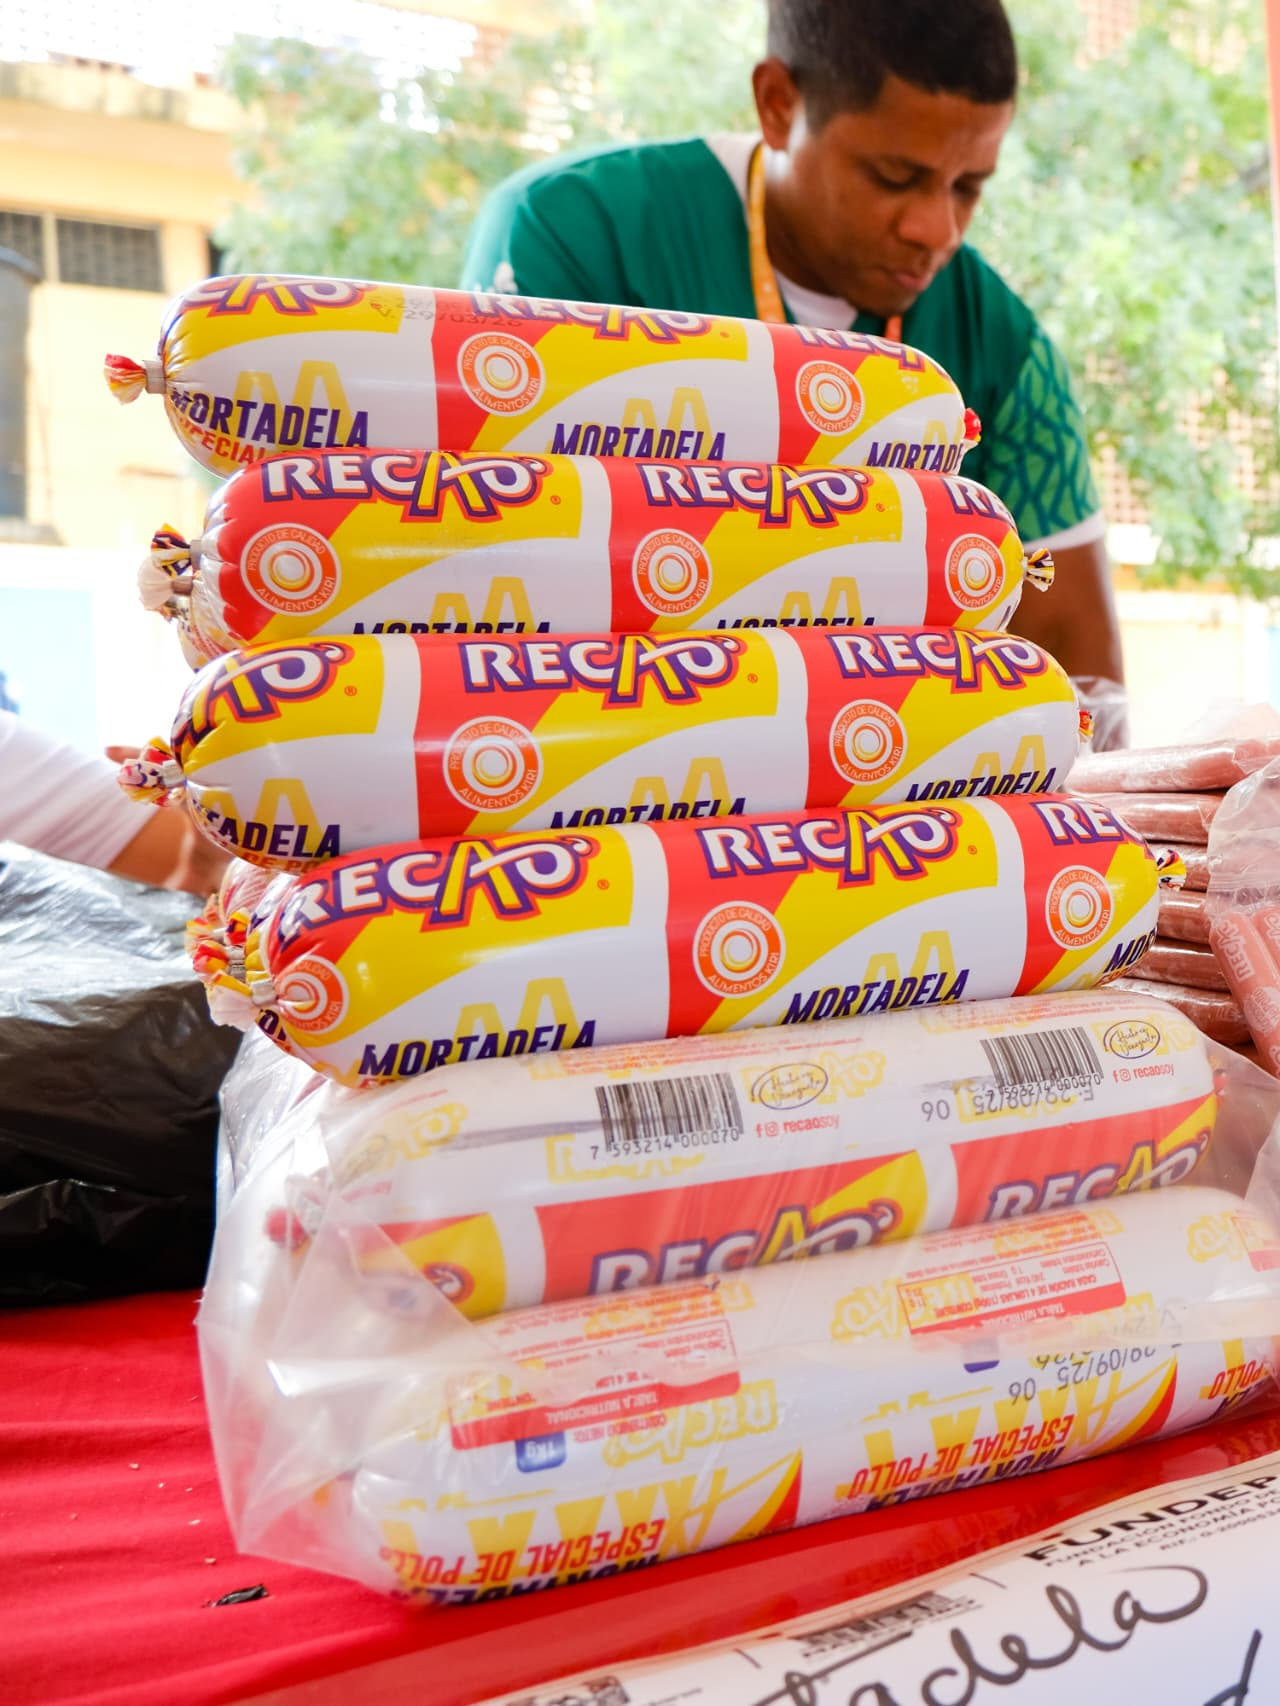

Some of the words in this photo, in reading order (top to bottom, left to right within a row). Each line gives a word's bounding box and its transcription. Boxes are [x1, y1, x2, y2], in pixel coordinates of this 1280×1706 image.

[261, 451, 548, 518] RECAO
[638, 463, 872, 528] RECAO
[462, 633, 742, 708] RECAO
[830, 630, 1050, 692] RECAO
[699, 806, 966, 884] RECAO
[278, 836, 598, 951] RECAO
[780, 969, 972, 1025] MORTADELA
[920, 1098, 951, 1122] 06
[1007, 1377, 1037, 1406] 06
[932, 1442, 965, 1475] DE
[971, 1414, 1074, 1463] ESPECIAL
[849, 1453, 928, 1501] POLLO
[470, 1551, 514, 1587] DE
[526, 1518, 666, 1575] ESPECIAL
